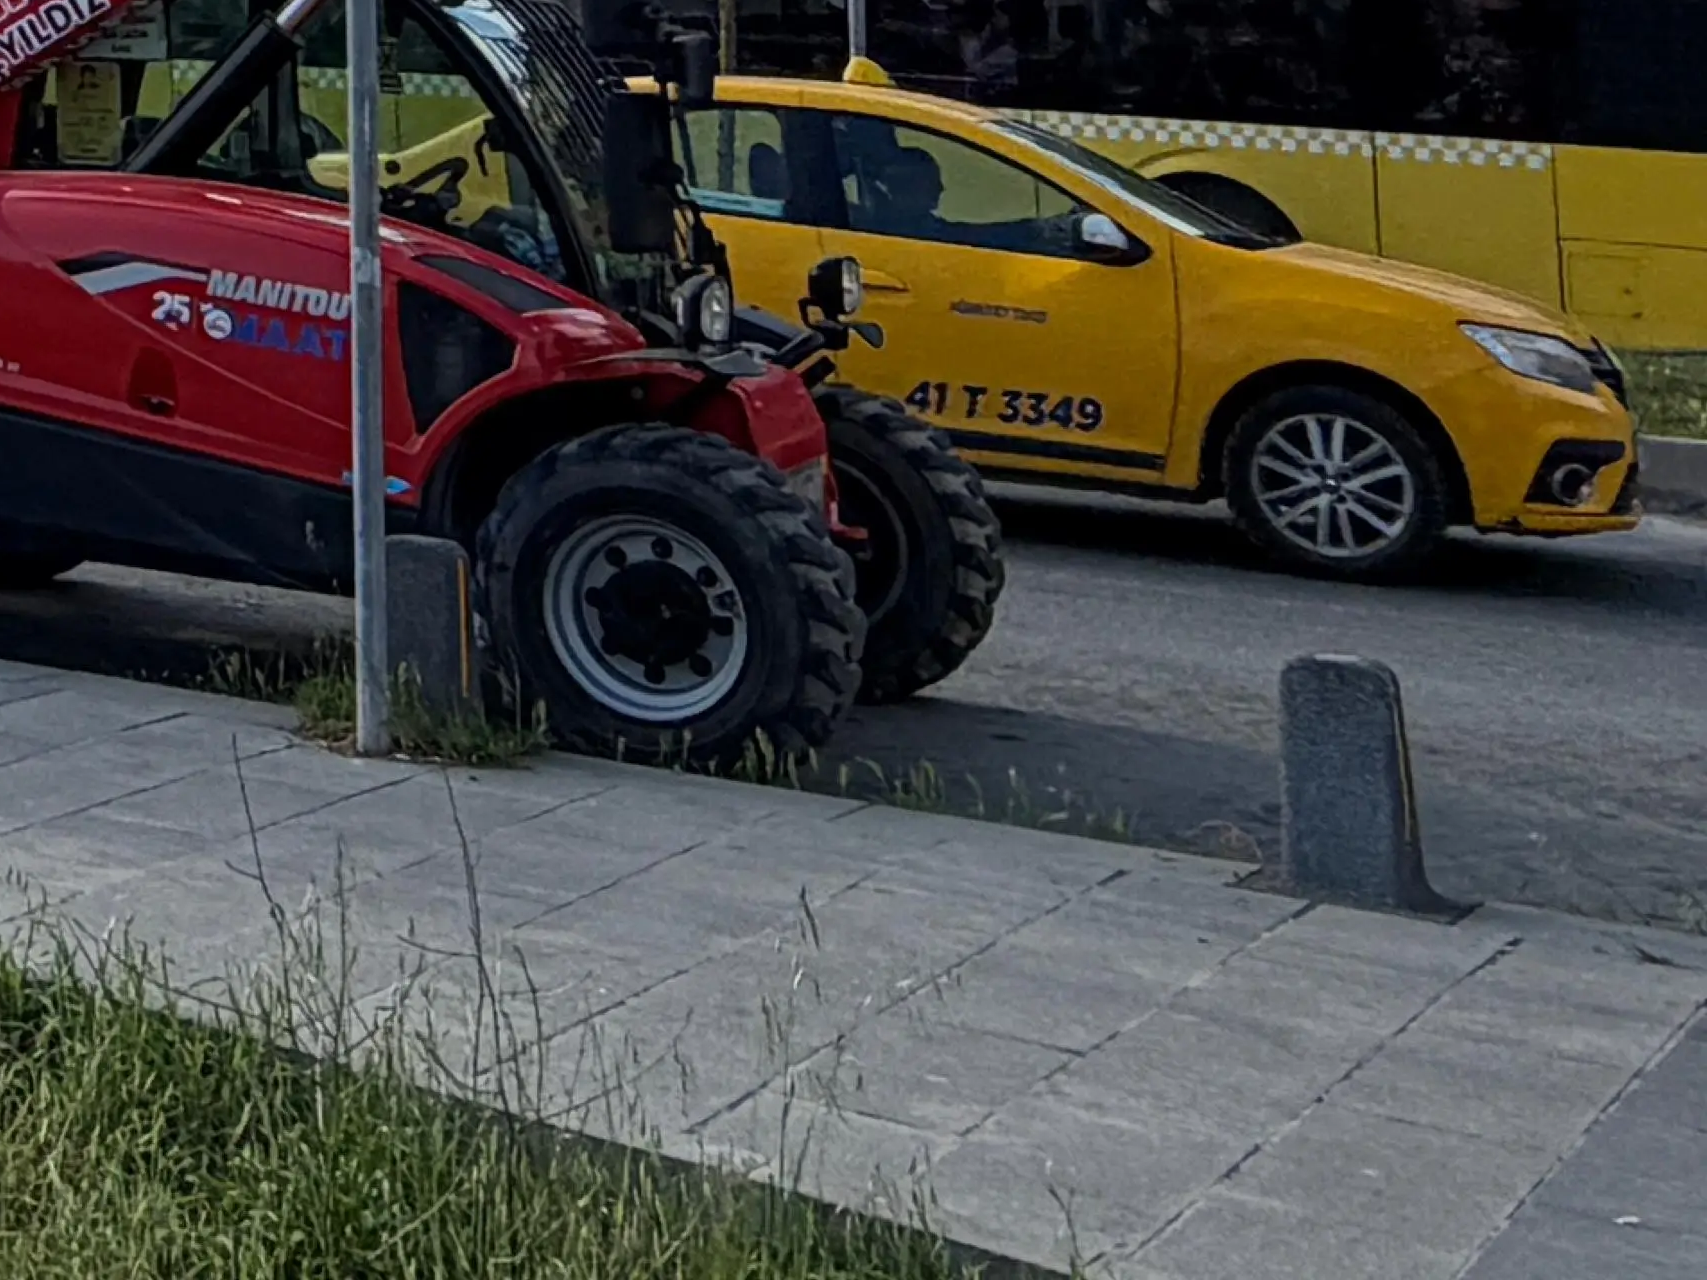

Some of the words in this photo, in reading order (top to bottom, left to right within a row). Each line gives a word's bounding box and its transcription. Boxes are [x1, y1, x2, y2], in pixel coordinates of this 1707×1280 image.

[151, 290, 190, 324] 25
[206, 268, 352, 321] MANITOU
[904, 380, 950, 416] 41
[961, 384, 989, 419] T
[995, 389, 1104, 433] 3349
